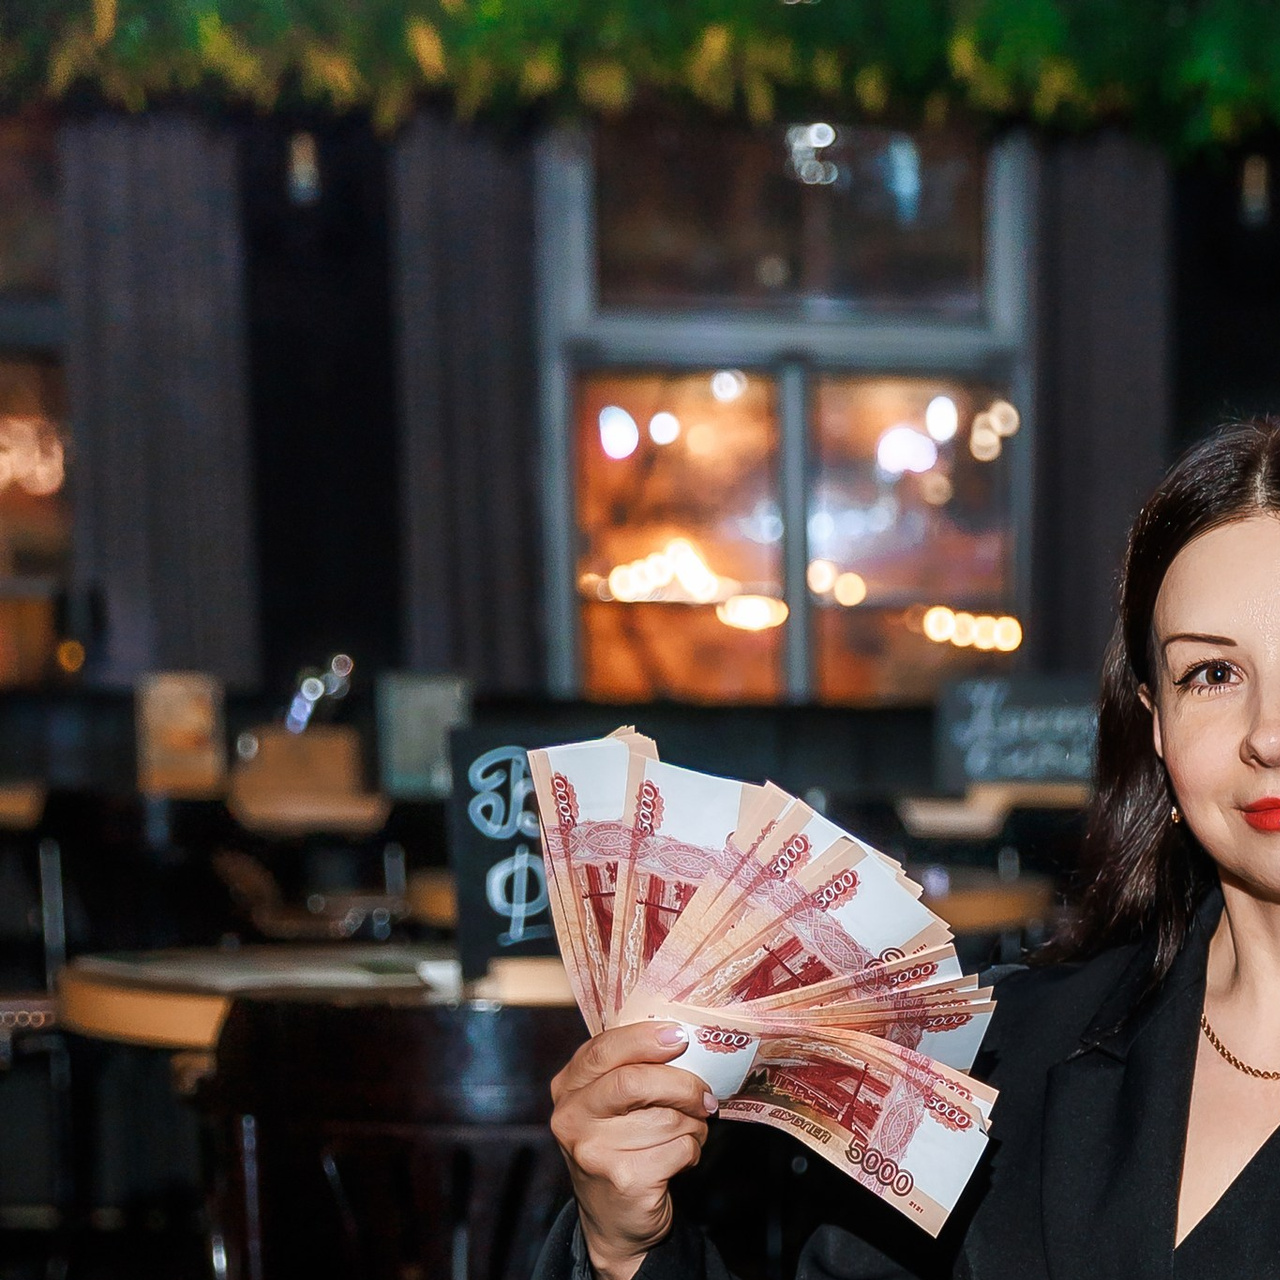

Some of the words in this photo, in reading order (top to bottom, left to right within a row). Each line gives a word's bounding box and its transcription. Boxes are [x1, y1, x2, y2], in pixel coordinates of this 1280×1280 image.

[553, 778, 572, 827] 5000
[638, 785, 655, 835] 5000
[771, 837, 805, 879] 5000
[814, 872, 854, 908] 5000
[889, 964, 933, 986] 5000
[699, 1029, 747, 1048] 5000
[926, 1014, 967, 1027] 5000
[928, 1095, 969, 1126] 5000
[845, 1137, 914, 1196] 5000
